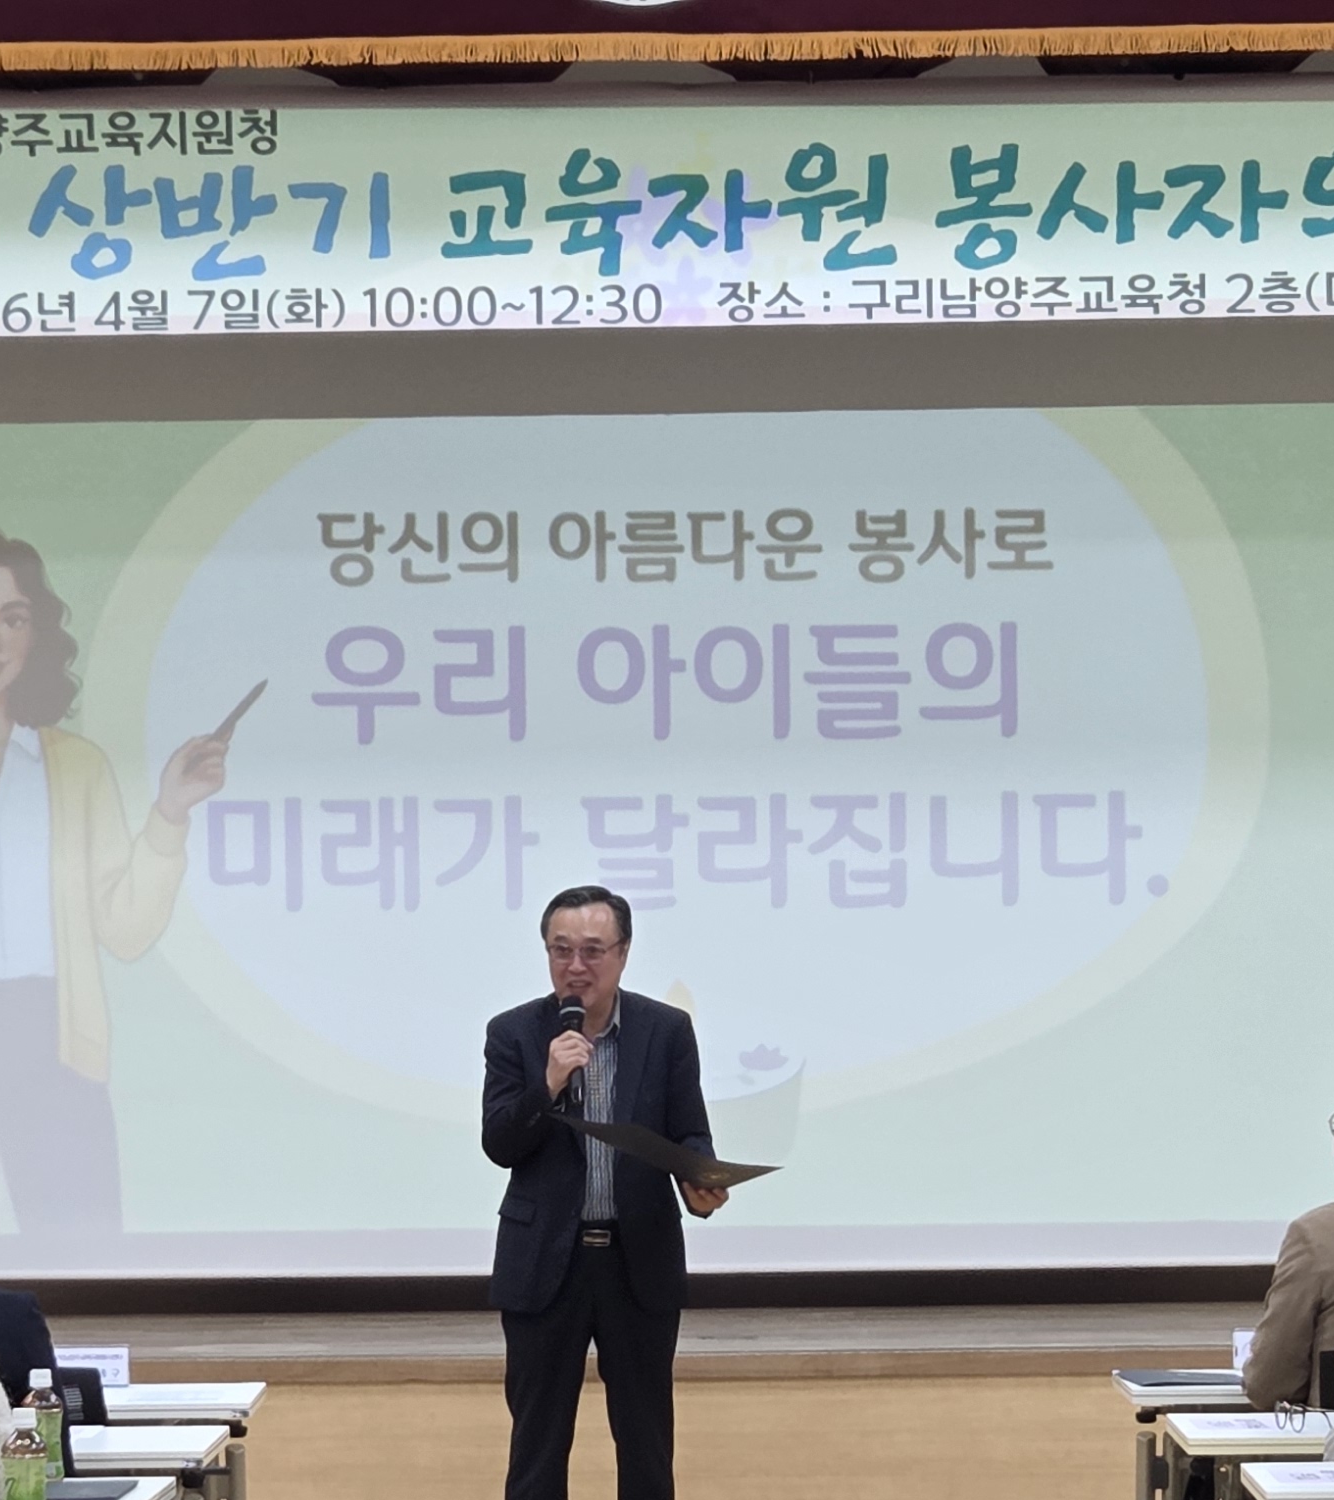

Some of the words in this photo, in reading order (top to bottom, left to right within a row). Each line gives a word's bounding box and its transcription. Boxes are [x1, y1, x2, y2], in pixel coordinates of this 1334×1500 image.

[28, 164, 391, 281] 상반기
[440, 142, 899, 277] 교육자원
[94, 290, 169, 332] 4월
[186, 286, 346, 331] 7일(화)
[362, 283, 663, 327] 10:00~12:30
[717, 281, 805, 323] 장소
[848, 273, 1208, 320] 구리남양주교육청
[318, 510, 520, 588] 당신의
[547, 507, 823, 585] 아름다운
[848, 506, 1054, 582] 봉사로
[311, 623, 528, 746] 우리
[575, 620, 1020, 742] 아이들의
[206, 795, 540, 913] 미래가
[579, 789, 1170, 911] 달라집니다.
